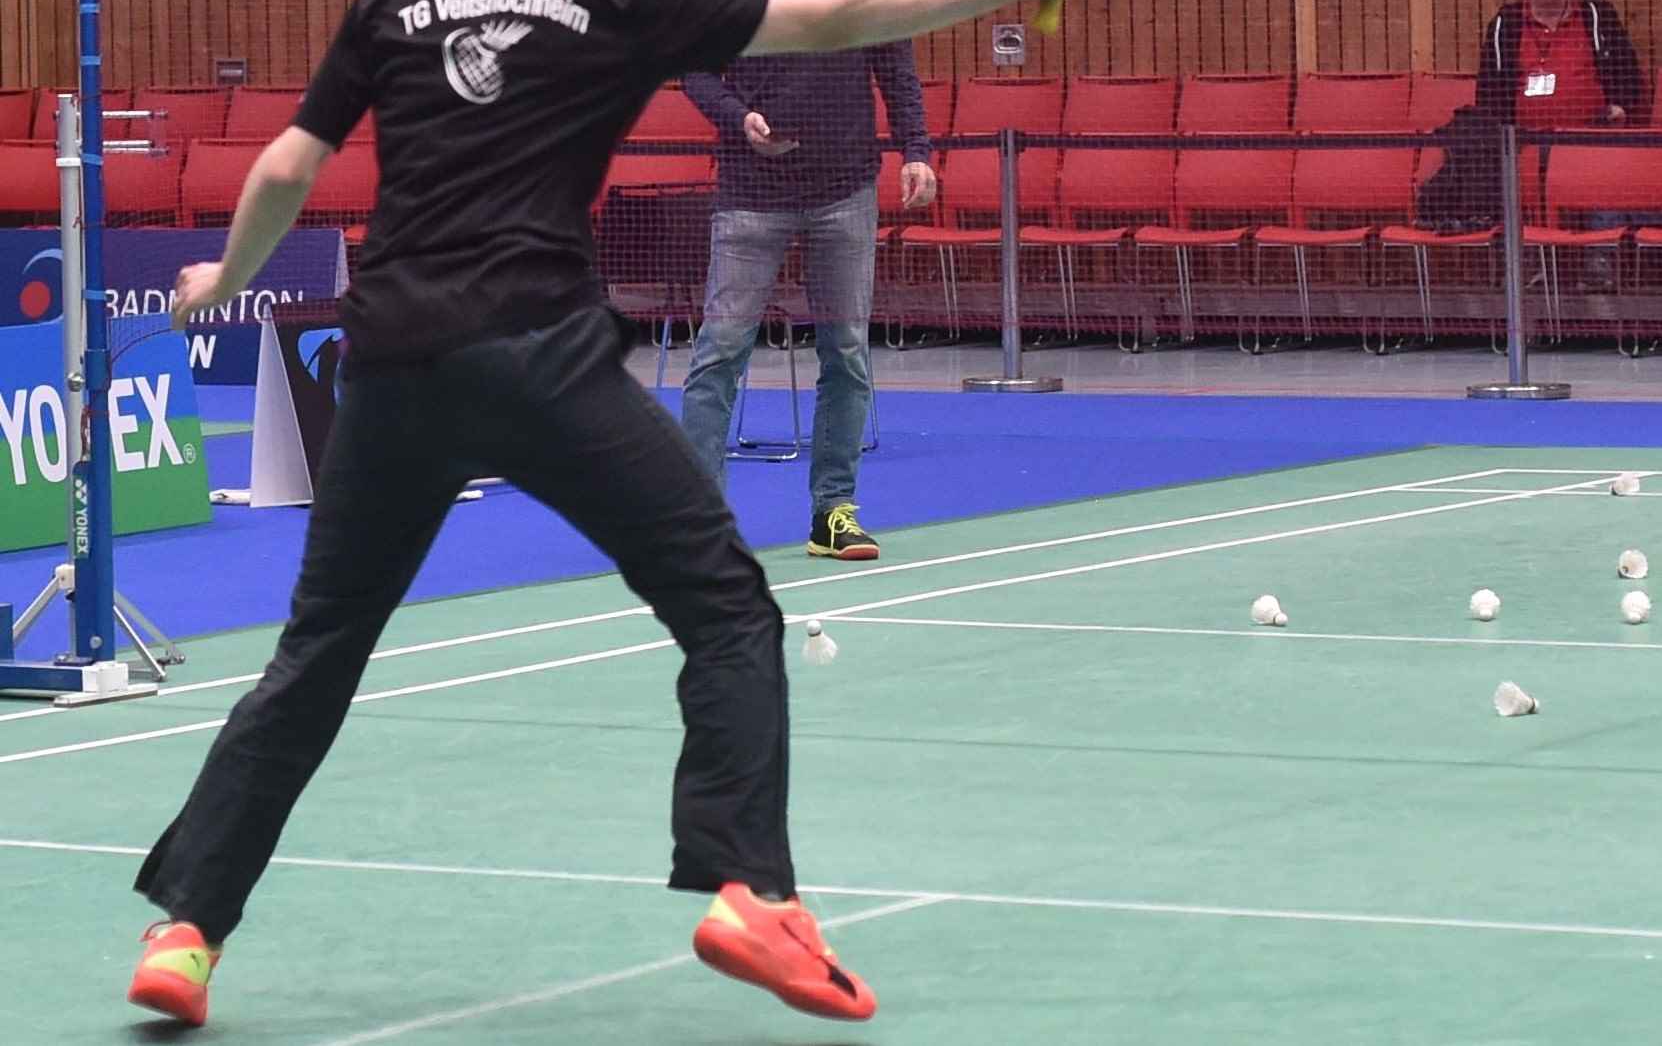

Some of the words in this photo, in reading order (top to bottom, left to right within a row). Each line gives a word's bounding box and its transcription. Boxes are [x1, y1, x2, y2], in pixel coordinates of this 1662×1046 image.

[398, 0, 432, 35] TG
[0, 374, 184, 486] YOEX
[75, 507, 89, 554] YONEX
